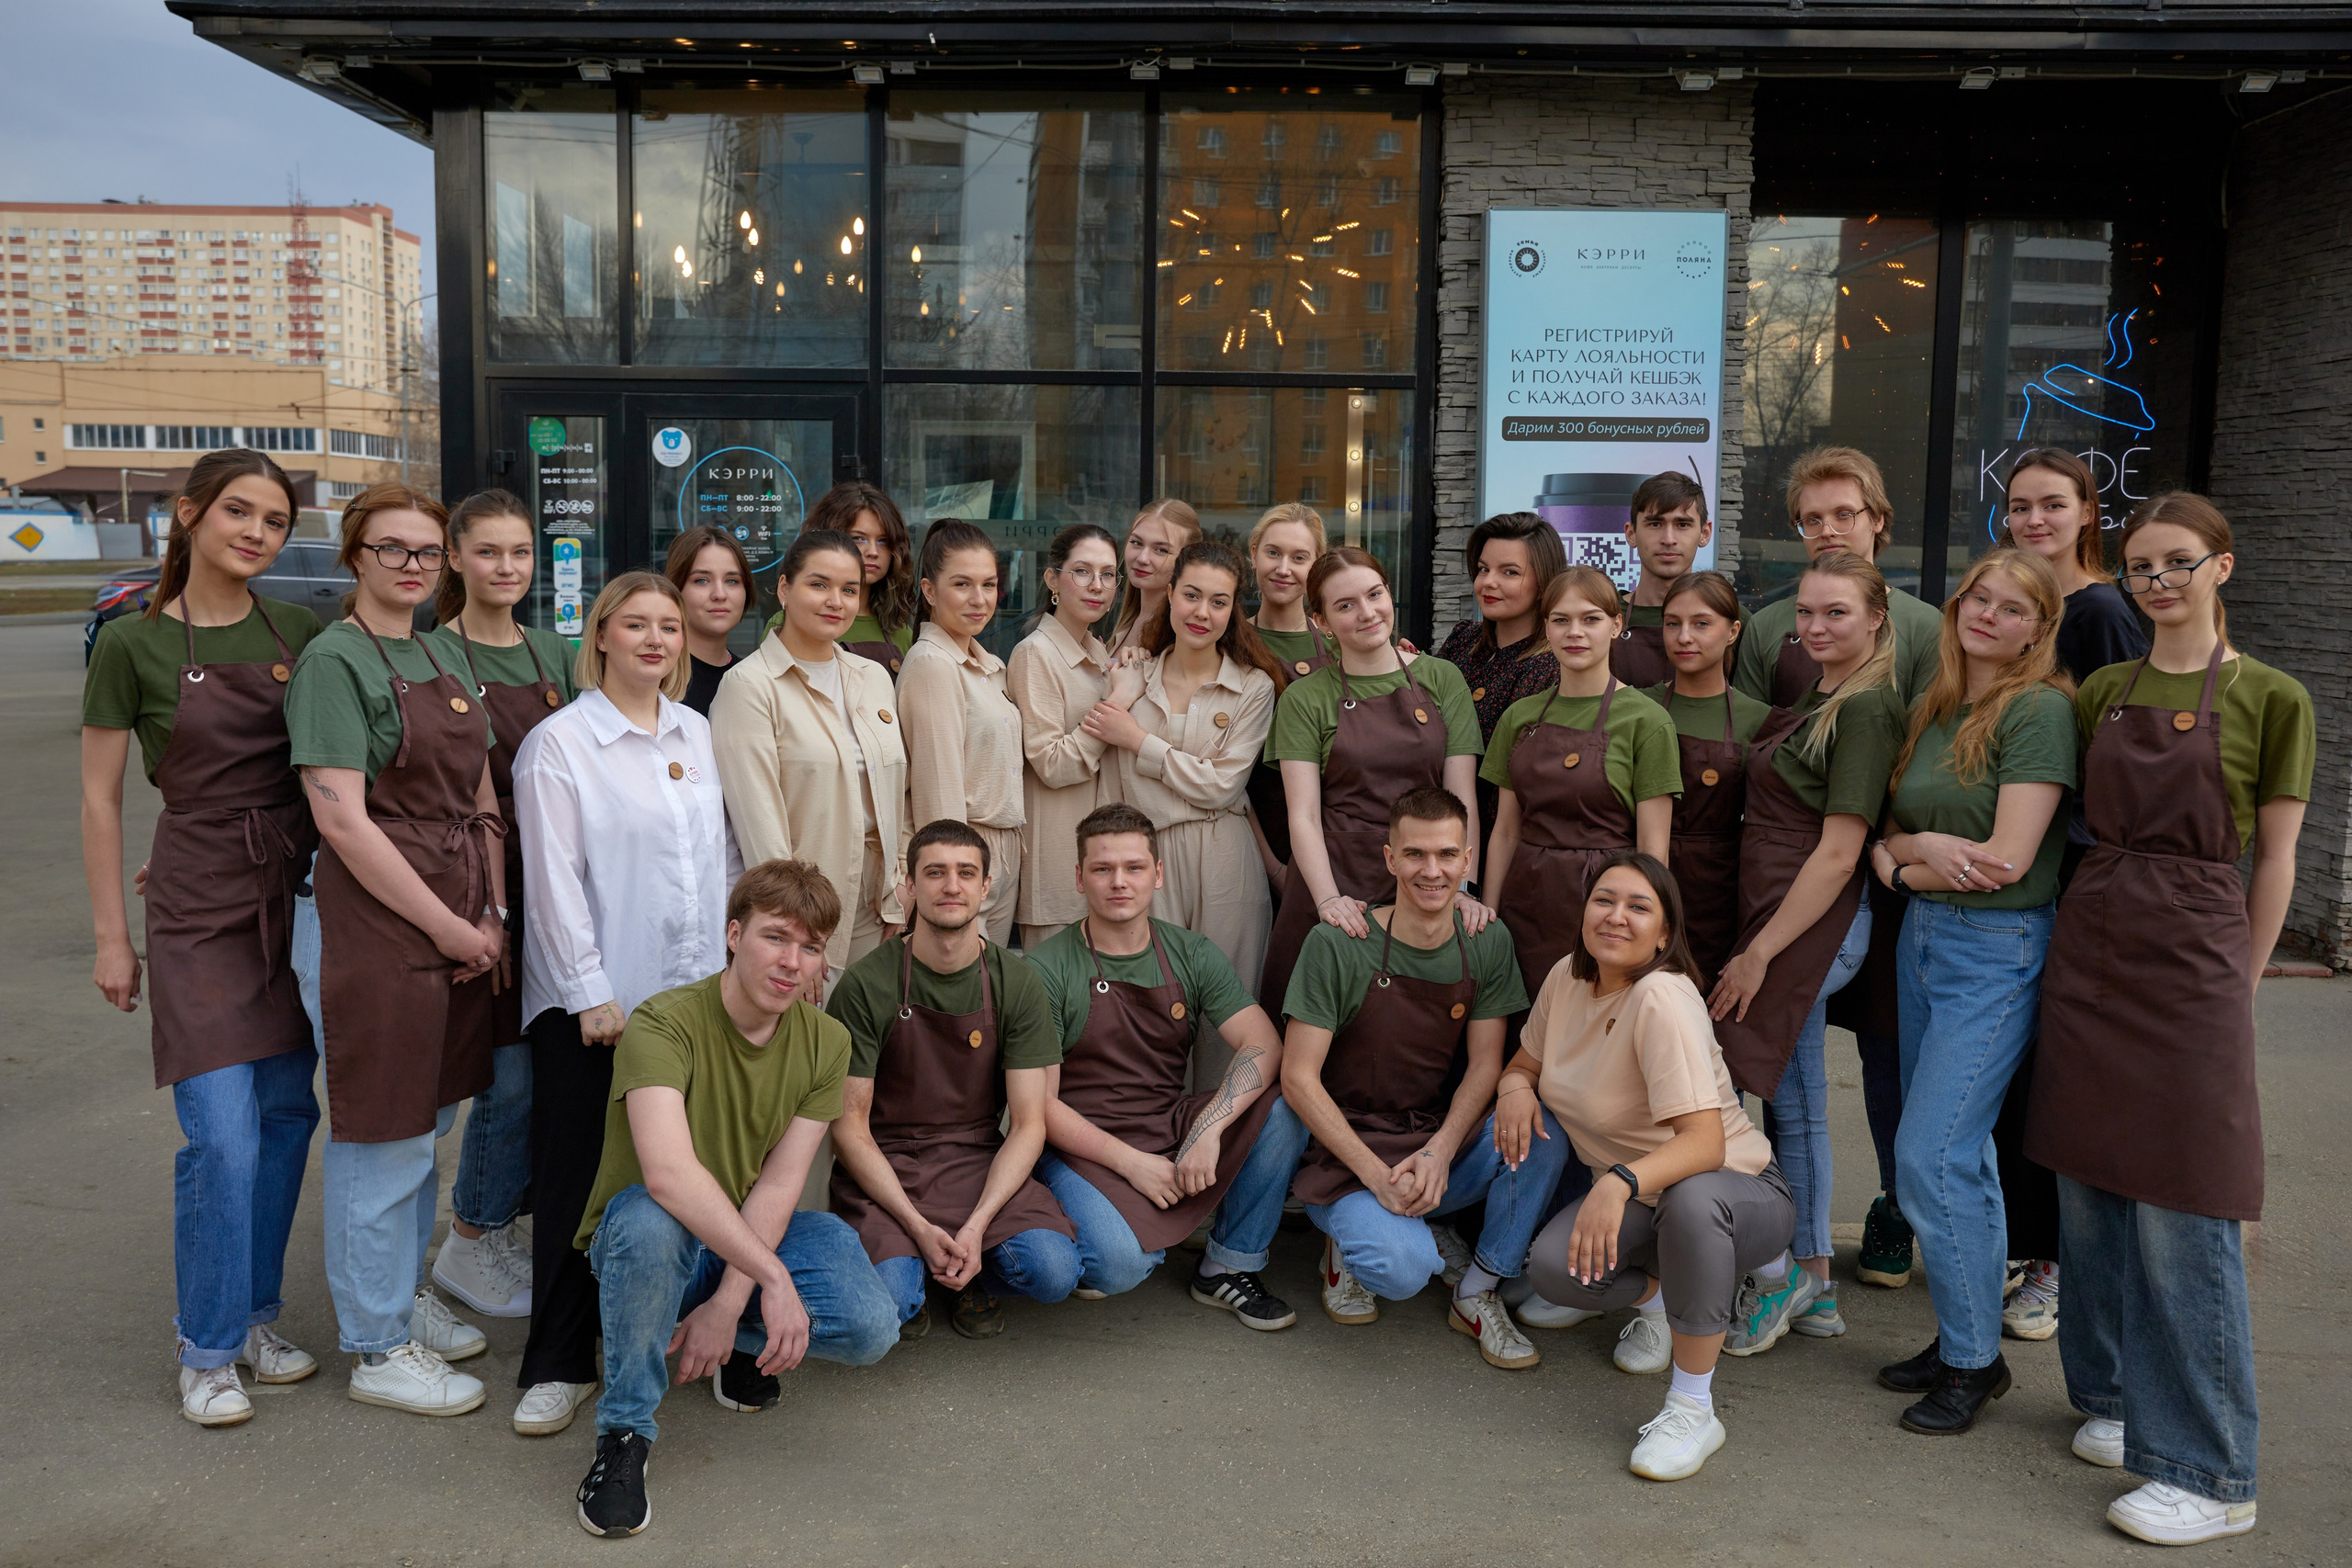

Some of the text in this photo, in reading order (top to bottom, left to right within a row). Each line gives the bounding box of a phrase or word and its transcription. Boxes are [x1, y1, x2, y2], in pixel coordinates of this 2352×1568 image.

[1577, 248, 1645, 260] КЭРРИ
[1544, 327, 1673, 344] РЕГИСТРИРУЙ
[1511, 349, 1704, 365] КАРТУ ЛОЯЛЬНОСТИ
[1512, 368, 1702, 385] И ПОЛУЧАЙ КЕШБЭК
[1508, 390, 1706, 406] С КАЖДОГО ЗАКАЗА!
[1507, 422, 1704, 437] Дарим 300 бонусных рублей
[708, 468, 774, 479] КЭРРИ
[1979, 446, 2152, 502] КФЕ
